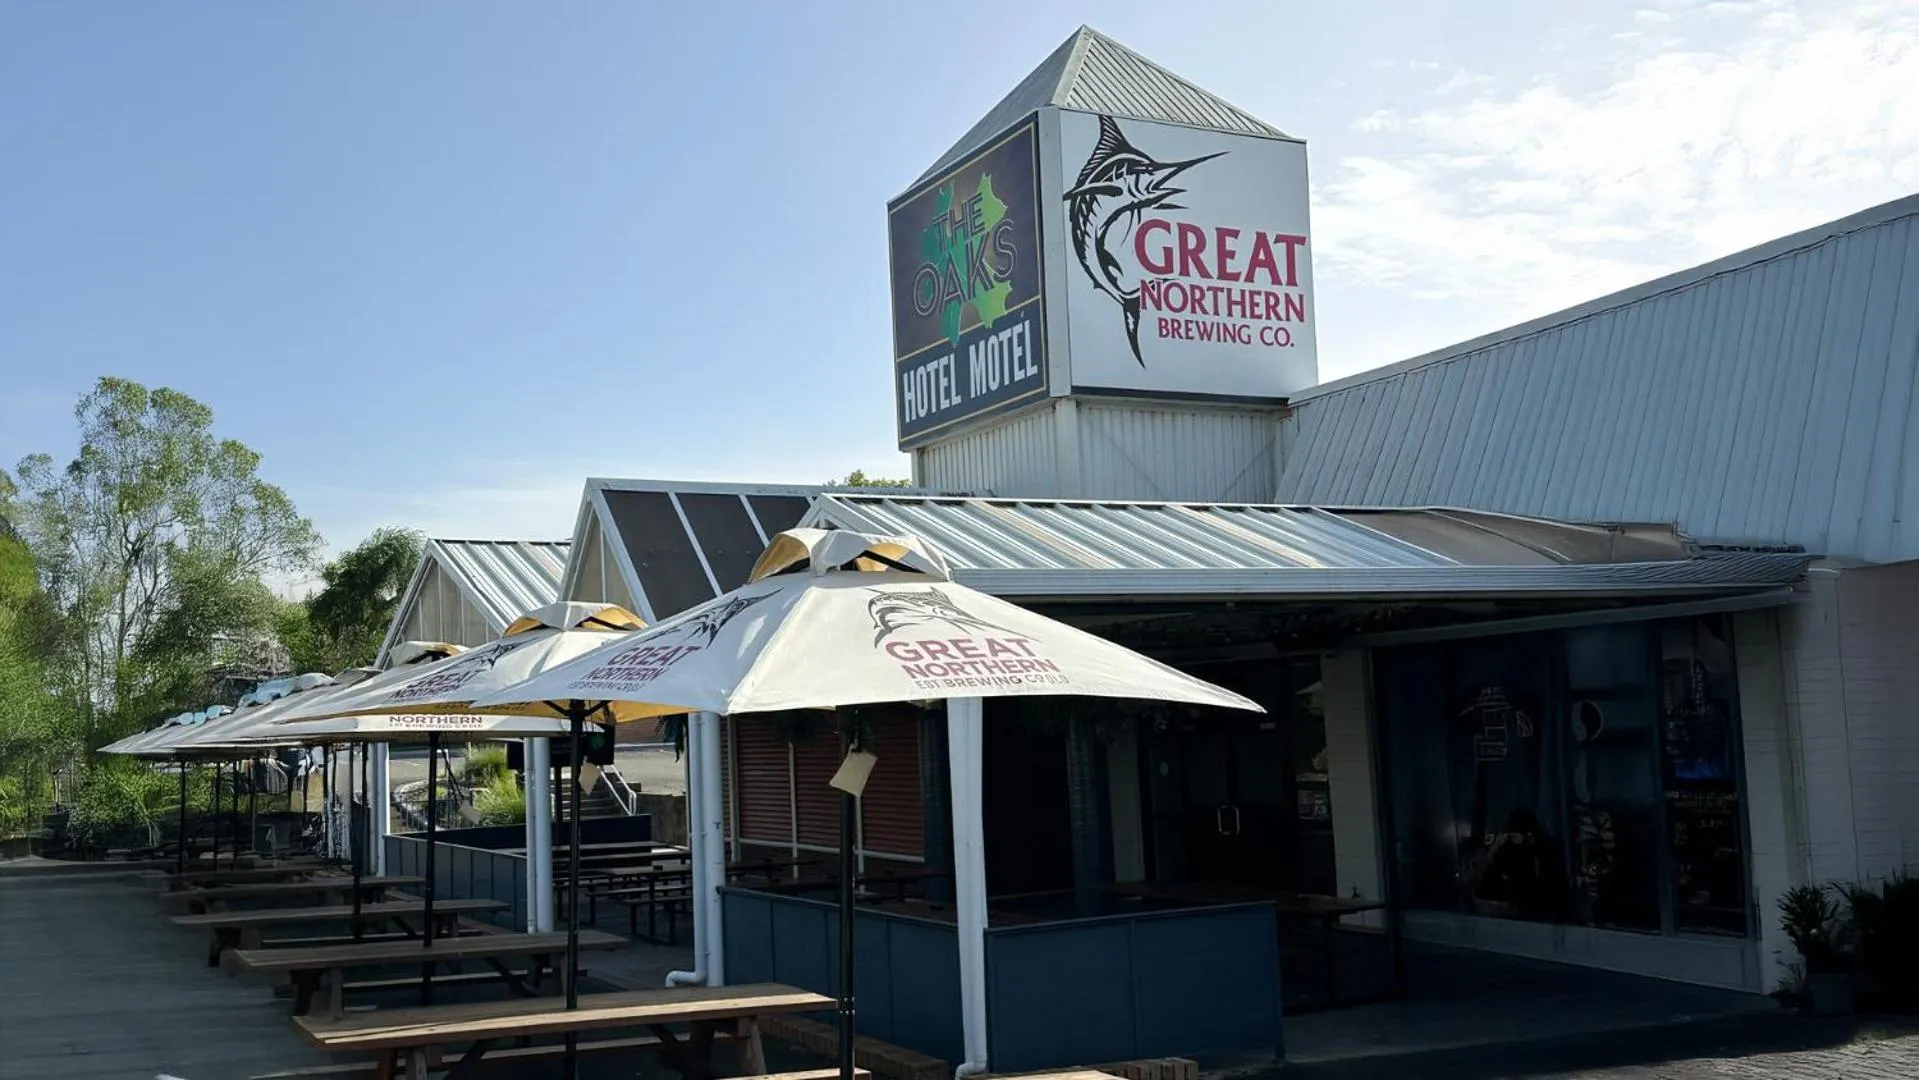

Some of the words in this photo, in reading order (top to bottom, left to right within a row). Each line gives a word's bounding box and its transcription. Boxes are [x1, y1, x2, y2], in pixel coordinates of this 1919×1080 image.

[932, 192, 985, 254] THE
[1134, 218, 1307, 288] GREAT
[912, 219, 1017, 317] OAKS
[1140, 279, 1306, 323] NORTHERN
[1158, 322, 1252, 346] BREWING
[1259, 326, 1296, 347] CO.
[903, 352, 962, 424] HOTEL
[969, 319, 1039, 399] MOTEL
[607, 645, 702, 666] GREAT
[885, 638, 1038, 662] GREAT
[580, 667, 670, 682] NORTHERN
[901, 658, 1062, 680] NORTHERN
[943, 675, 1023, 689] BREWING
[389, 716, 483, 724] NORTHERN
